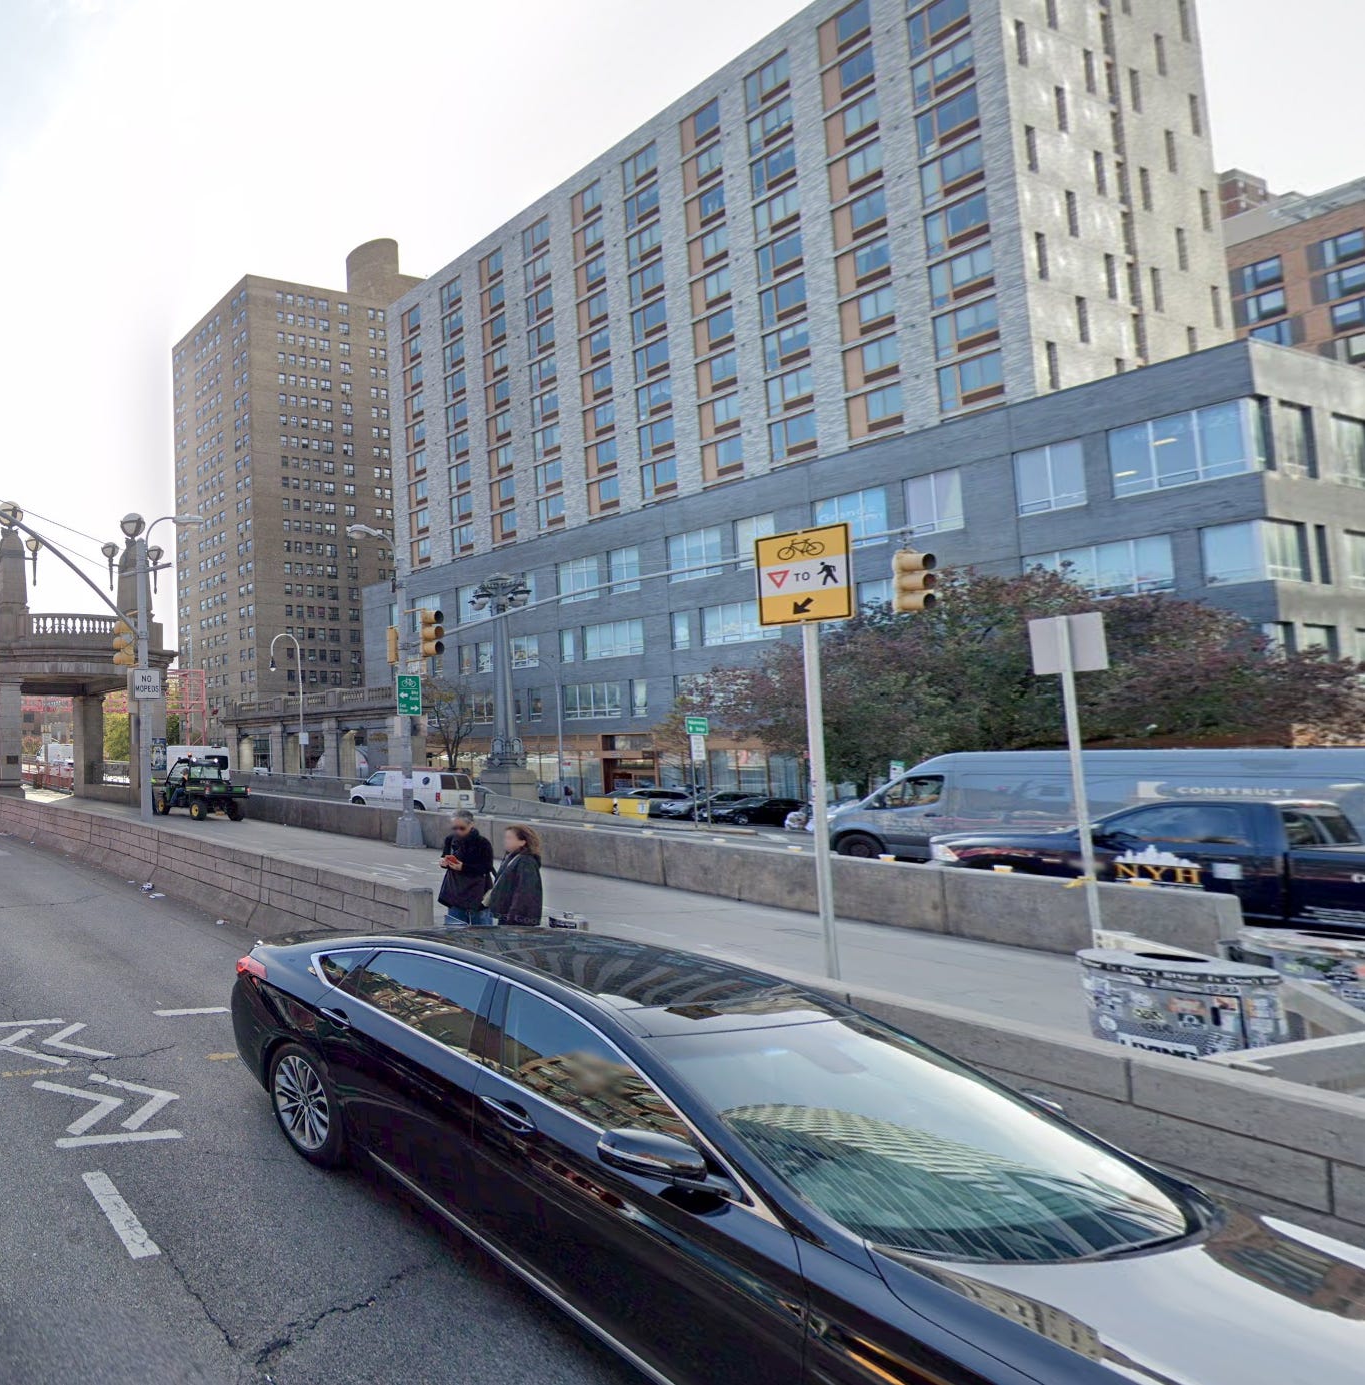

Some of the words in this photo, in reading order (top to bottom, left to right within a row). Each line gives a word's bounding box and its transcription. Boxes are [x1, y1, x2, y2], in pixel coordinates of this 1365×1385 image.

[794, 571, 810, 581] TO
[141, 675, 152, 683] NO
[136, 685, 159, 693] MOPEDS
[1176, 785, 1296, 797] CONSTRUCT
[1114, 862, 1202, 885] NYH
